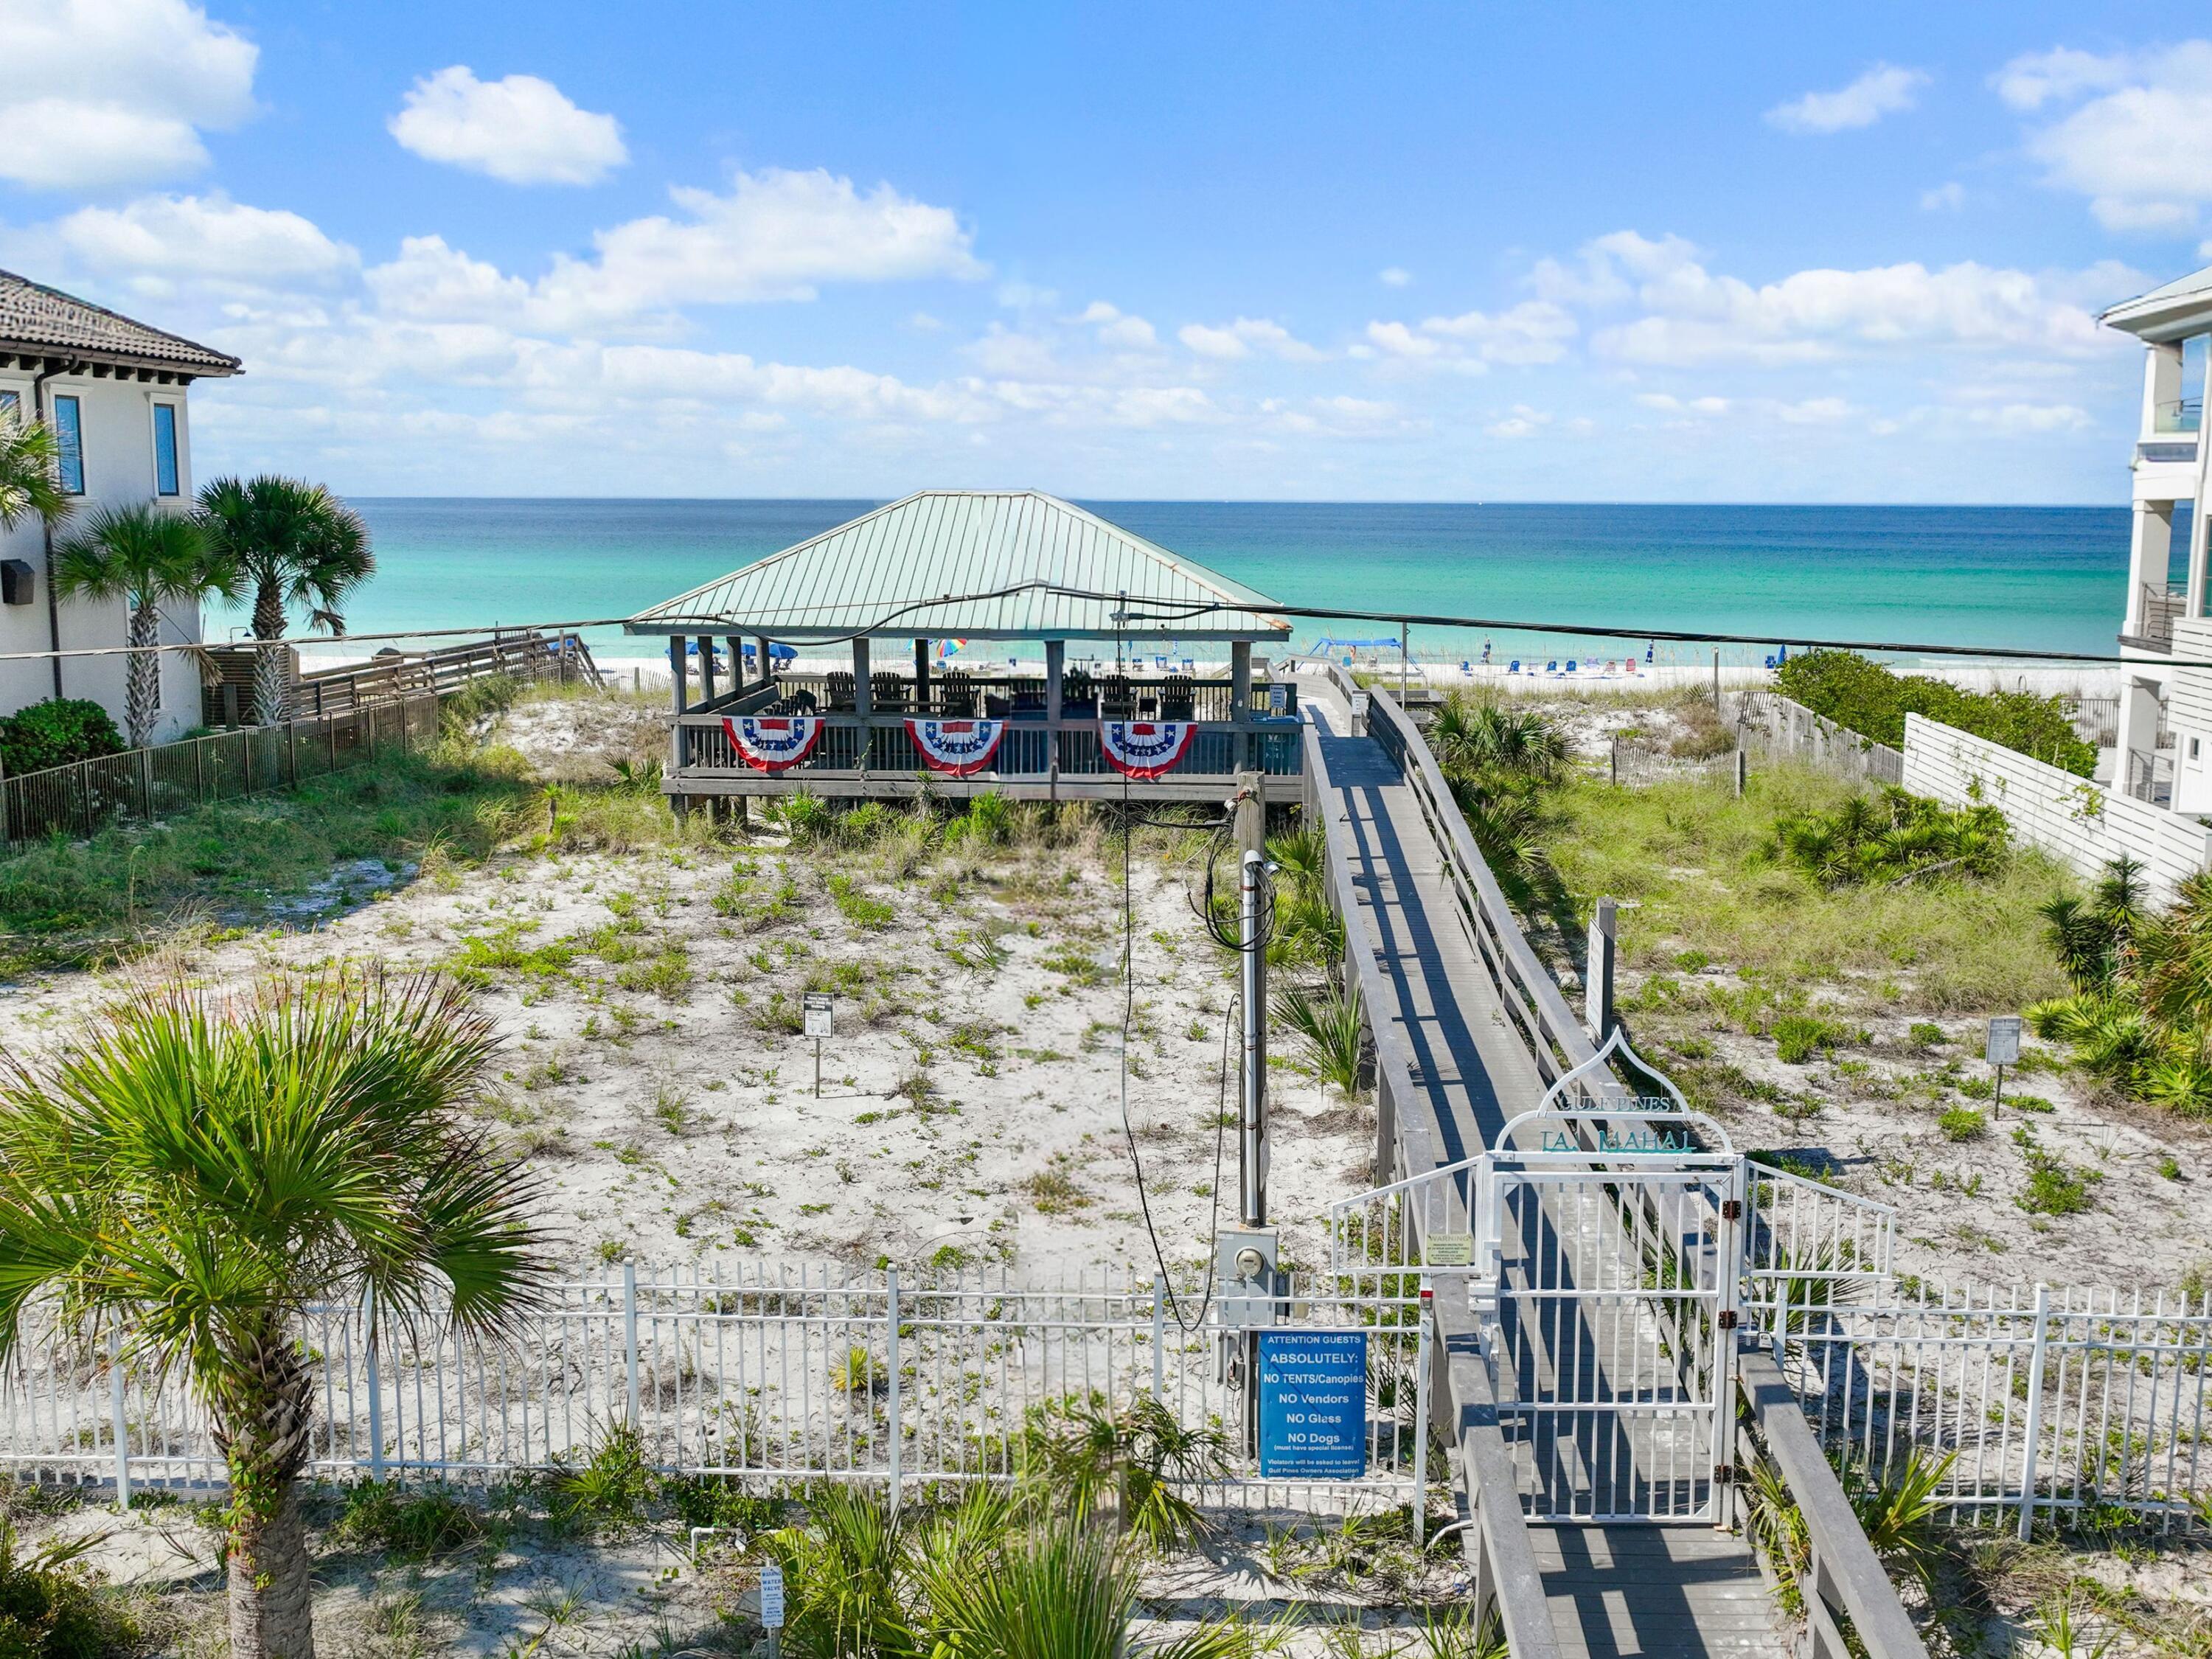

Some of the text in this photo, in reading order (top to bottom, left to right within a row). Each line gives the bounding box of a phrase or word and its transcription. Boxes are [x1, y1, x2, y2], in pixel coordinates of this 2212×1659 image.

[1560, 1095, 1671, 1112] GULF PINES
[1599, 1130, 1696, 1152] MAHAL
[1270, 1353, 1358, 1363] ABSOLUTELY:
[1264, 1373, 1364, 1386] NO TENTS/Canopies
[1279, 1394, 1349, 1404] NO Vendors
[1286, 1413, 1342, 1423] NO Glass
[1288, 1433, 1340, 1445] NO Dogs
